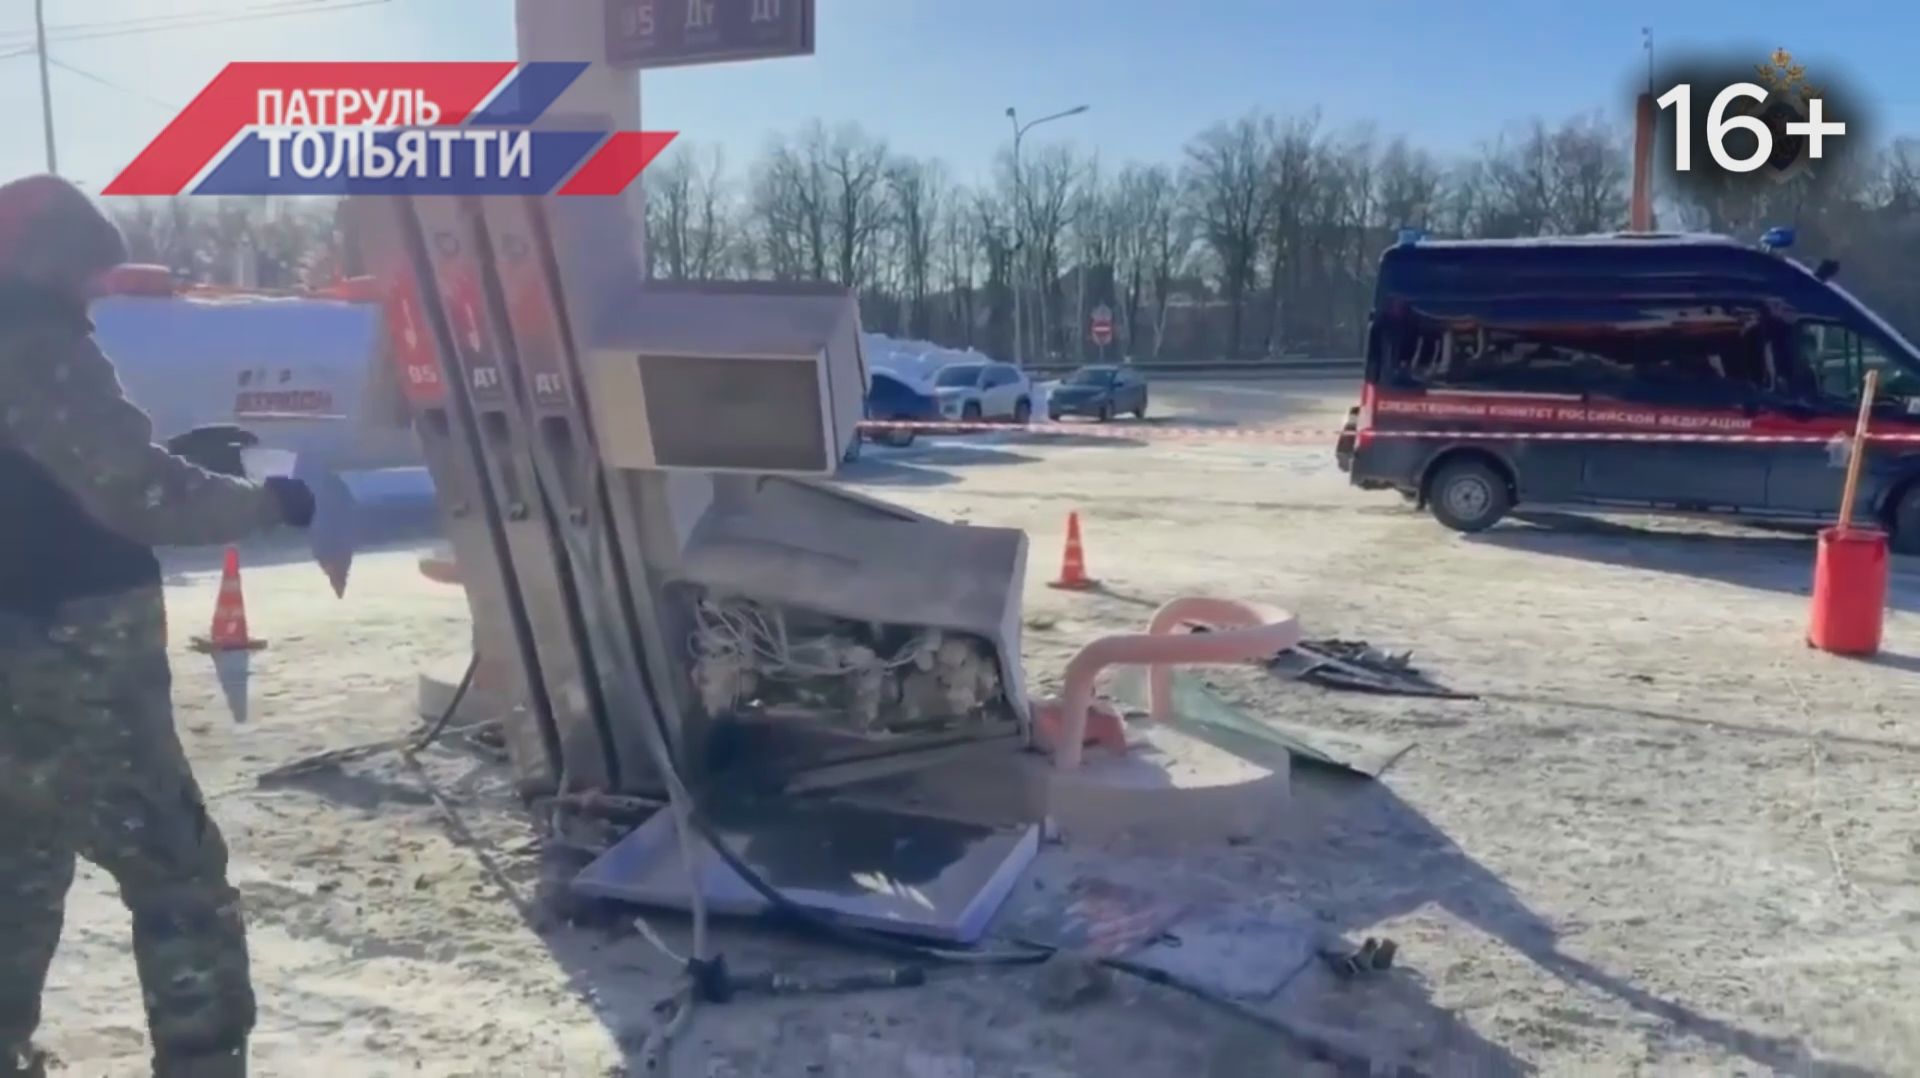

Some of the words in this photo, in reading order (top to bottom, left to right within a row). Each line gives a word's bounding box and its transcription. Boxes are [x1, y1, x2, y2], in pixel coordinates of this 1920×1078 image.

[408, 364, 438, 384] 95
[1557, 408, 1656, 425] РОССИЙСКОЙ
[1659, 414, 1752, 430] ФЕДЕРАЦИИ
